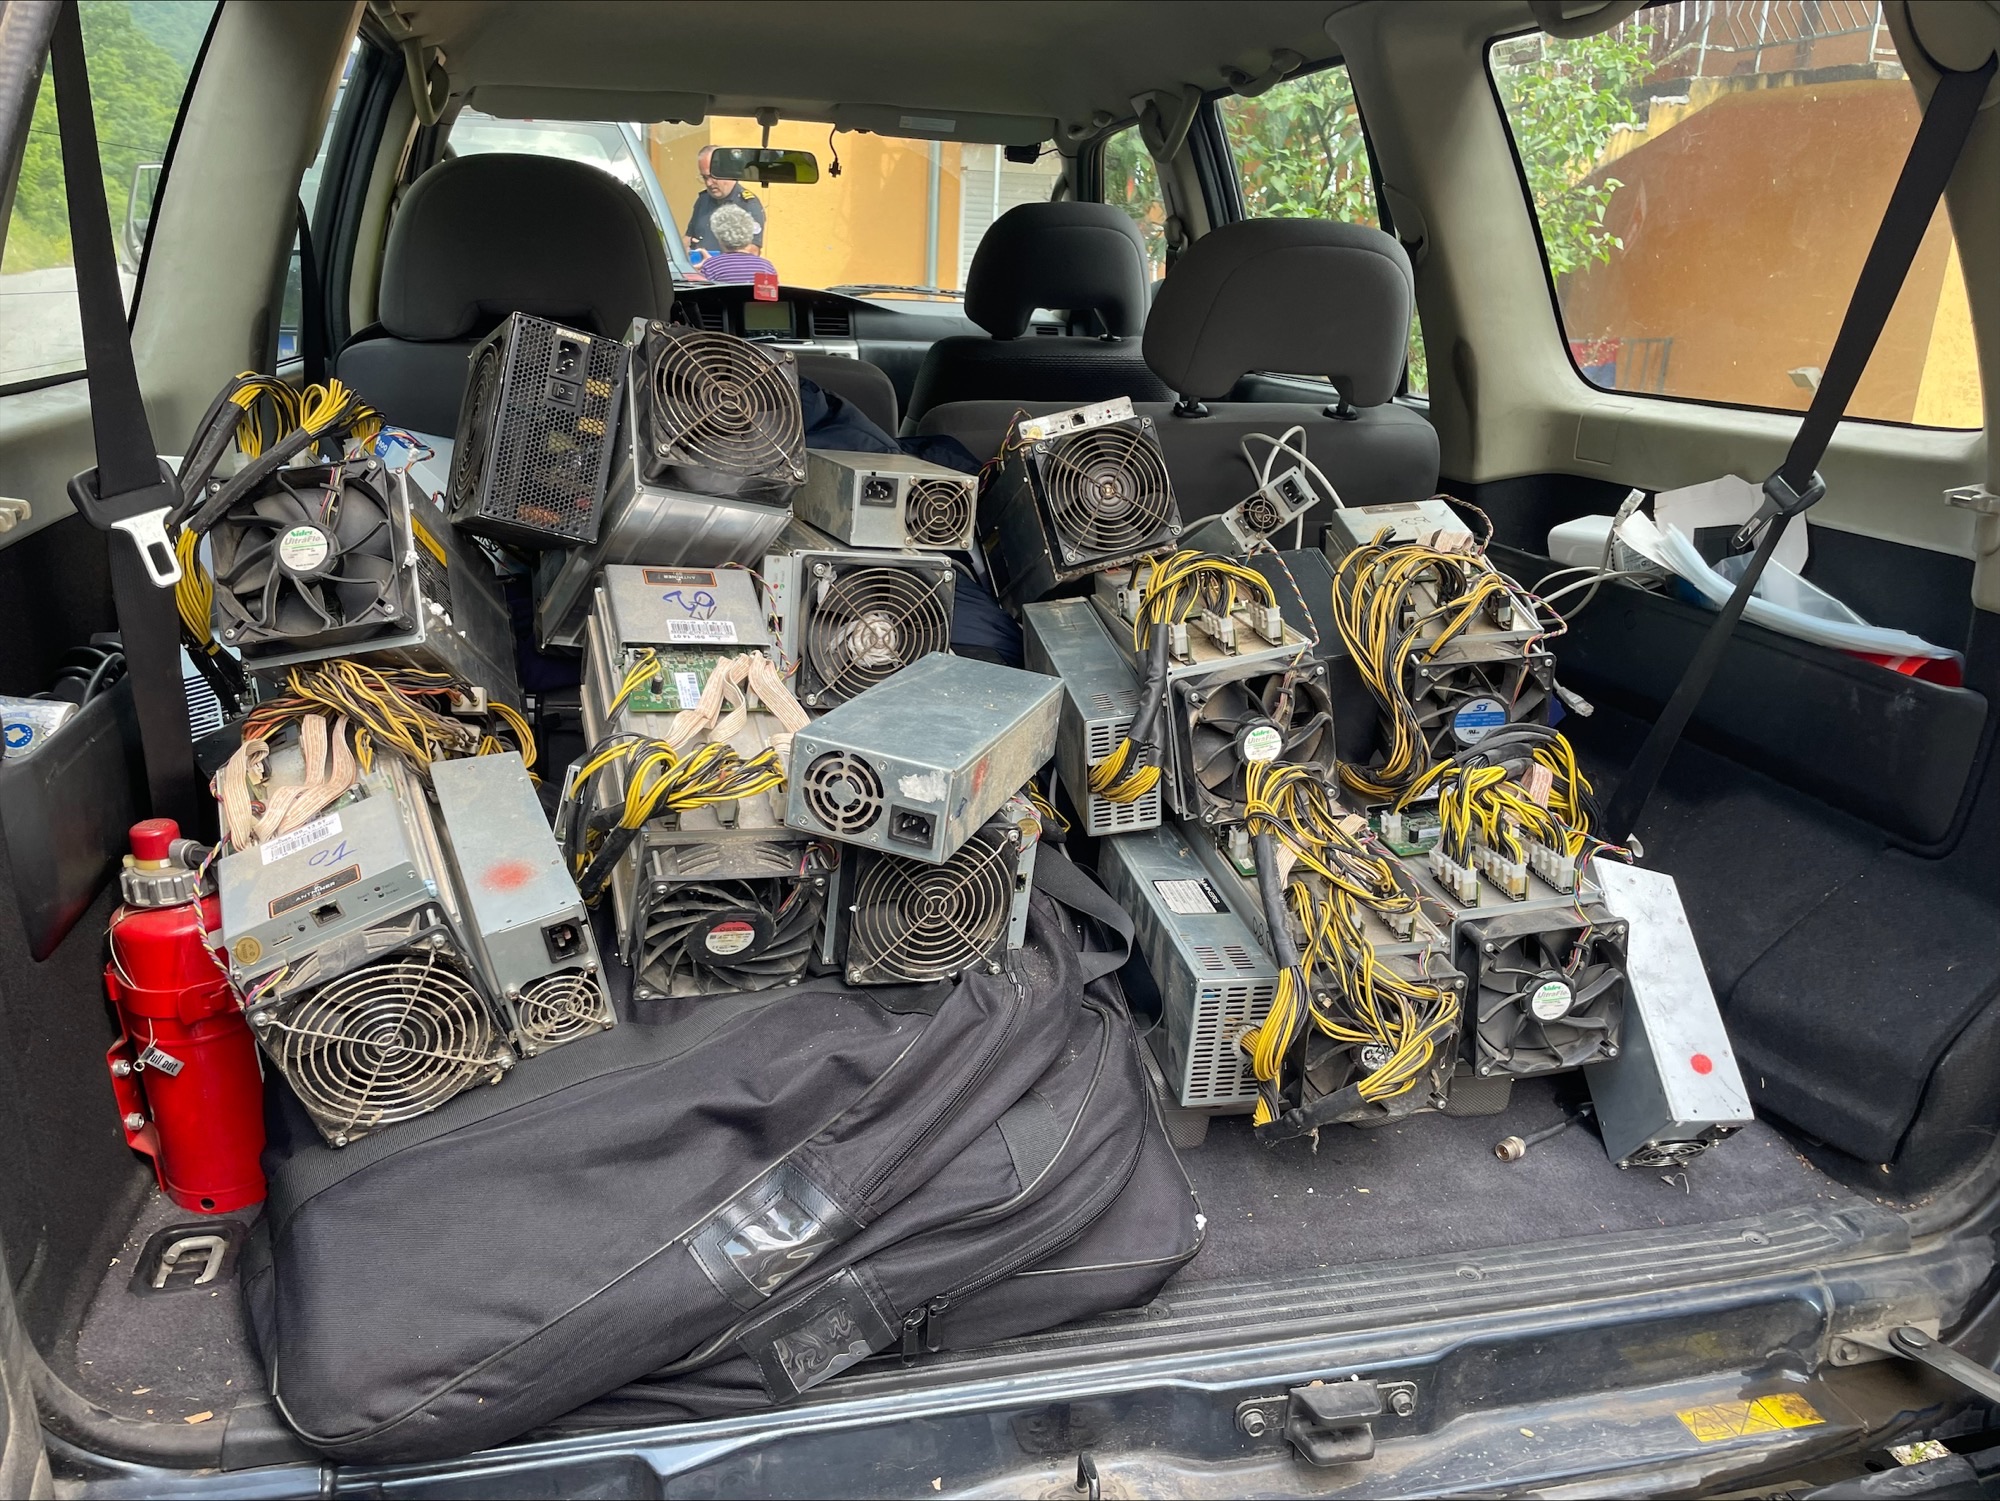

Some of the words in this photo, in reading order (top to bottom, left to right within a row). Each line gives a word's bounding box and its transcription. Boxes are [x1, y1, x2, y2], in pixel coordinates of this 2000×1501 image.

[295, 881, 336, 901] ANTMINER
[146, 1050, 165, 1066] Pull
[161, 1060, 178, 1073] out
